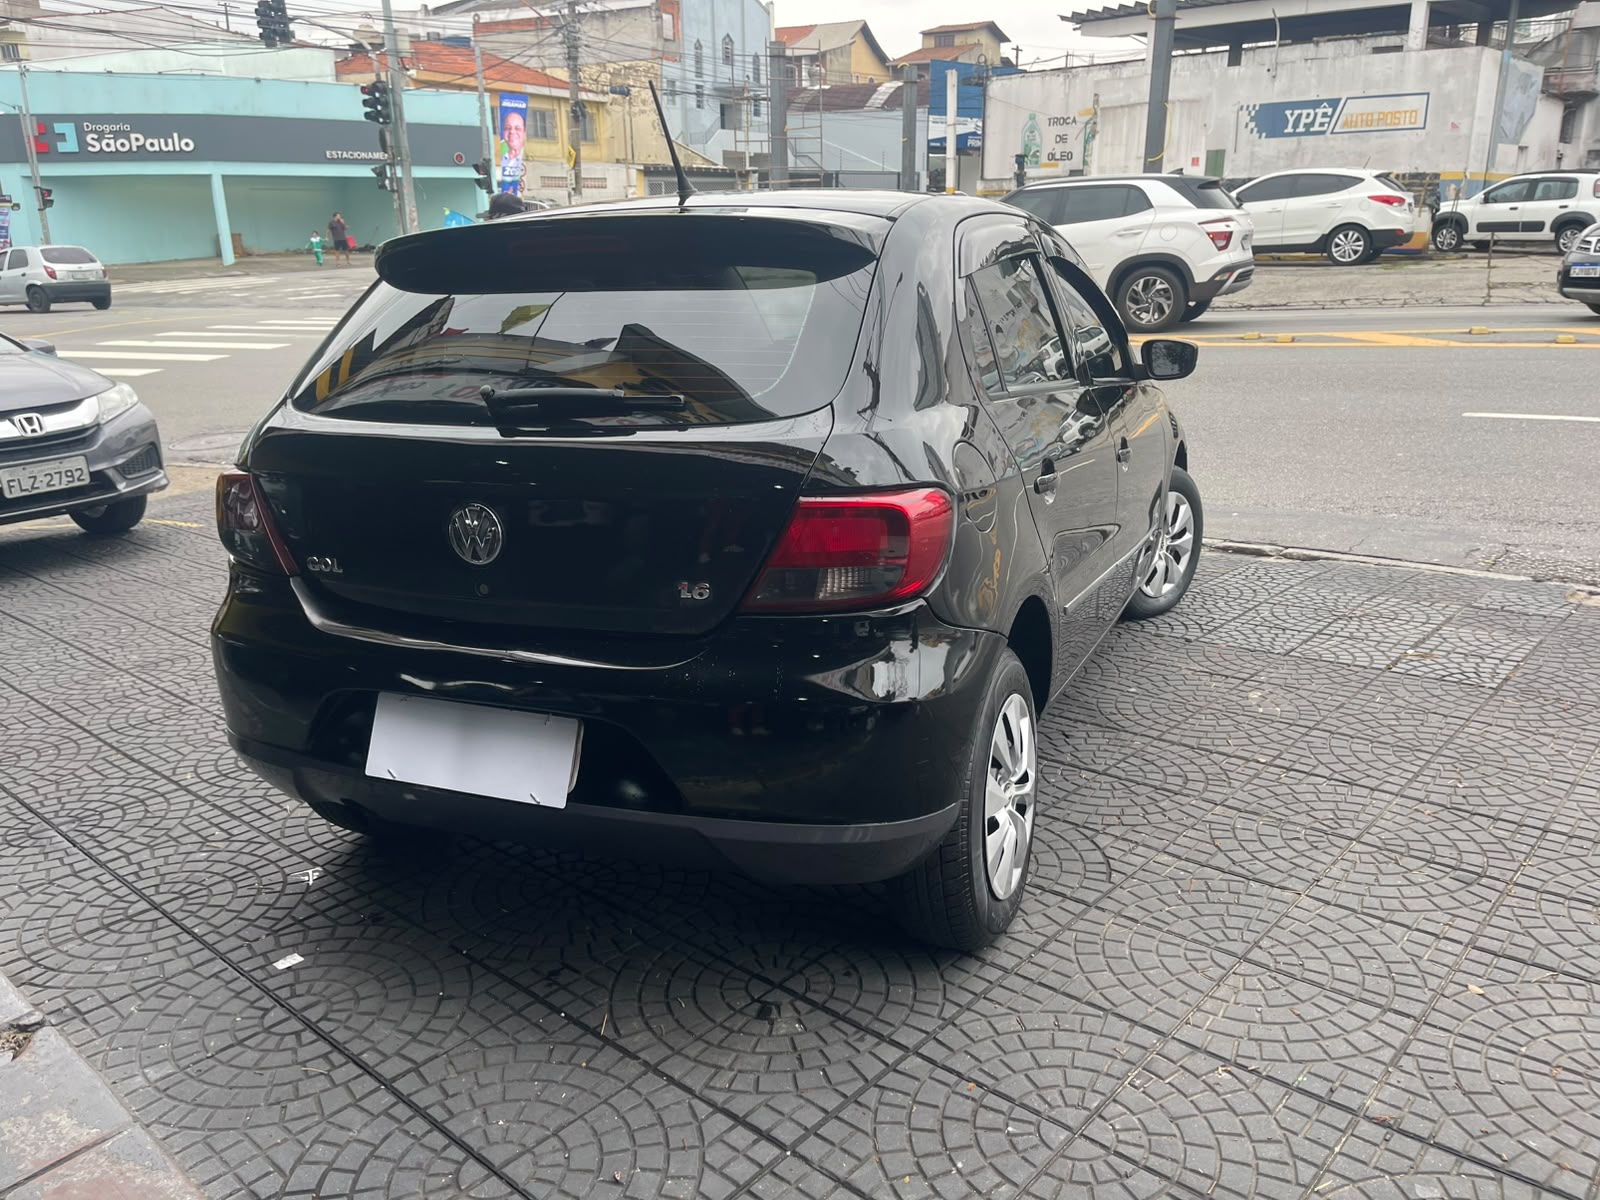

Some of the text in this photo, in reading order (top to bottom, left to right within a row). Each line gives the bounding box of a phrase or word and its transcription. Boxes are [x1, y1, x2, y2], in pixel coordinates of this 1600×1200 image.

[1047, 116, 1077, 127] TROCA
[1283, 102, 1333, 133] YPÊ
[1343, 109, 1419, 129] AUTO POSTO
[83, 122, 131, 134] Drogaria
[1054, 134, 1069, 144] DE
[1047, 147, 1073, 162] ÓLEO
[306, 556, 343, 574] GOL
